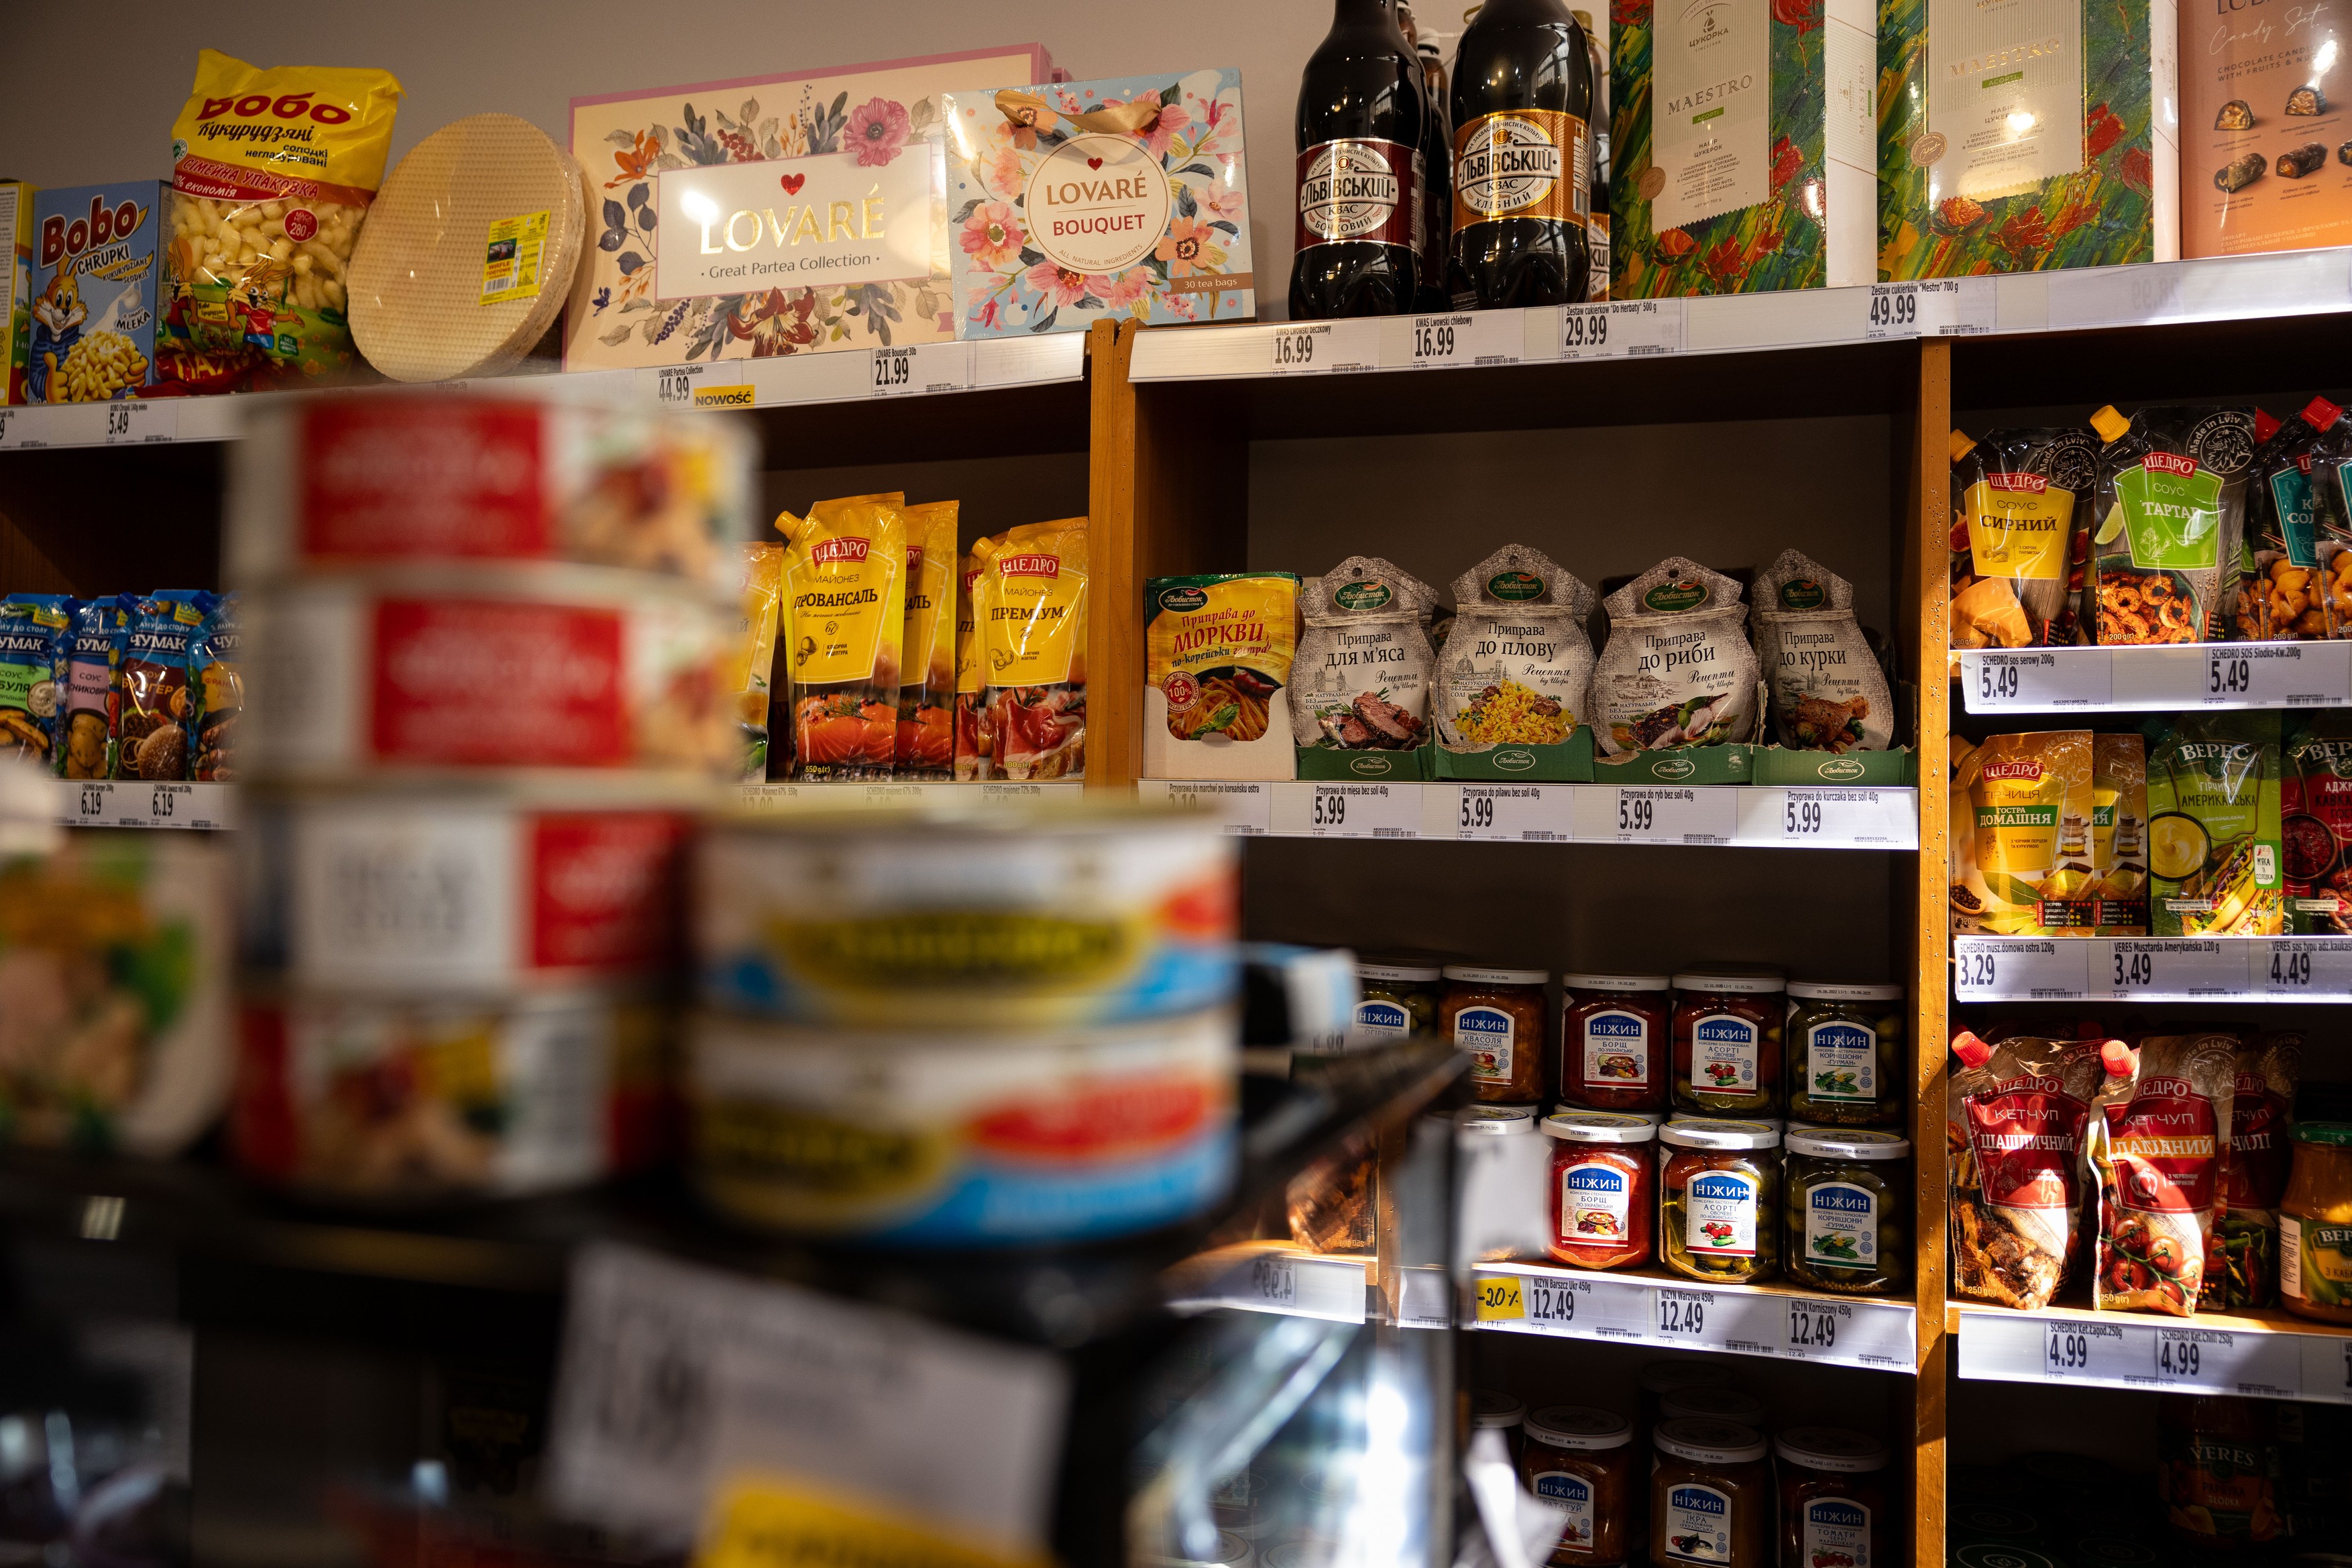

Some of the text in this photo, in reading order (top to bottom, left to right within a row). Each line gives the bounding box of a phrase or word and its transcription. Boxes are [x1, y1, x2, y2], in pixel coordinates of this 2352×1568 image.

[2209, 3, 2329, 55] Candy Set
[1689, 27, 1729, 48] ЦУКОРКА
[1949, 39, 2059, 79] MAESTRO
[2218, 54, 2274, 74] CHOCOLATE
[1668, 75, 1752, 115] MAESTRO
[1697, 111, 1719, 121] АСОРТІ
[198, 121, 315, 142] Кукурудзяні
[283, 144, 327, 158] солодкі
[1694, 145, 1722, 157] ЦУКЕРОК
[1461, 149, 1551, 184] ЛЬВІВСЬКИЙ
[182, 158, 318, 199] СІМЕЙНА УПАКОВКА
[1487, 179, 1518, 191] КВАС
[1047, 169, 1147, 206] LOVARÉ
[1304, 176, 1390, 207] ЛЬВІВСЬКИЙ
[1329, 205, 1358, 215] КВАС
[699, 182, 886, 255] LOVARÉ
[1052, 214, 1145, 236] BOUQUET
[40, 194, 139, 269] Bobo
[77, 244, 129, 275] CHRUPKI
[710, 254, 871, 278] Great Partea Collection
[1184, 277, 1238, 288] 30 tea bags
[1871, 281, 1958, 296] Zestaw cukierków "Mestro" 700 g
[1567, 302, 1657, 317] Zestaw cukierków "Do Herbaty" 500 g
[1870, 294, 1916, 326] 49.99
[117, 312, 151, 330] MLEKA
[1416, 315, 1473, 327] KWAS Lwowski chlebowy
[1565, 315, 1607, 346] 29.99
[1276, 335, 1313, 363] 16.99
[1415, 326, 1454, 357] 16.99
[876, 349, 891, 358] LOVARE
[892, 348, 908, 358] Bouquet
[659, 366, 704, 378] LOVARE Partea Collection
[876, 357, 909, 385] 21.99
[659, 376, 689, 402] 44.99
[695, 391, 751, 406] NOWOŚĆ
[109, 412, 129, 434] 5.49
[2145, 455, 2193, 473] ЩЕДРО
[1991, 475, 2044, 490] ЩЕДРО
[2153, 483, 2185, 496] СОУС
[1997, 500, 2037, 510] СОУС
[1981, 516, 2057, 531] СИРНИЙ
[1003, 559, 1056, 573] ЩЕДРО
[814, 574, 859, 584] МАЙОНЕЗ
[1494, 581, 1537, 590] Любисток
[794, 589, 878, 608] ПРОВАНСАЛЬ
[1005, 587, 1053, 596] МАЙОНЕЗ
[1165, 595, 1202, 603] Любисток
[1341, 588, 1385, 601] Любисток
[1652, 590, 1700, 602] Любисток
[991, 606, 1064, 621] ПРЕМІУМ
[1182, 608, 1255, 628] Приправа до
[1488, 622, 1545, 638] Приправа
[130, 636, 186, 650] ЧУМАК
[1174, 622, 1264, 655] МОРКВИ
[1337, 632, 1392, 649] Приправа
[1645, 630, 1706, 650] Приправа
[1785, 632, 1835, 648] Приправа
[1172, 646, 1230, 668] по-корейськи
[1326, 652, 1358, 669] для
[1638, 642, 1716, 673] до риби
[1780, 650, 1847, 671] до курки
[1982, 655, 2054, 667] SCHEDRO sos serowy 200g
[1375, 670, 1418, 684] Рецепти
[1522, 664, 1571, 677] Рецепти
[1687, 669, 1736, 684] Рецепти
[2210, 660, 2249, 692] 5.49
[1821, 672, 1860, 687] Рецепти
[1981, 667, 2018, 698] 5.49
[1168, 687, 1192, 697] 100%
[2179, 743, 2249, 761] ВЕРЕС
[1499, 757, 1530, 765] Любисток
[1985, 765, 2040, 777] ЩЕДРО
[1316, 786, 1388, 797] Przyprawa do mięsa bez soli 40g
[1463, 787, 1540, 799] Przyprawa do pilawu bez soli 40g
[1984, 790, 2040, 799] ГІРЧИЦЯ
[81, 792, 101, 815] 6.19
[153, 793, 173, 816] 6.19
[1314, 795, 1345, 824] 5.99
[1461, 797, 1493, 827] 5.99
[1619, 799, 1653, 830] 5.99
[1786, 801, 1821, 833] 5.99
[1980, 814, 2052, 827] ДОМАШНЯ
[1960, 942, 2055, 954] SCHEDRO musz.domowa ostra 120g
[2114, 941, 2220, 954] VERES Musztarda Amerykańska 120 g
[2272, 940, 2290, 951] VERES
[2292, 943, 2302, 951] sos
[2303, 942, 2316, 954] typu
[1960, 954, 1995, 986] 3.29
[2114, 954, 2151, 985] 3.49
[2271, 953, 2310, 985] 4.49
[1358, 1011, 1402, 1025] НІЖИН
[1462, 1019, 1505, 1031] НІЖИН
[1593, 1024, 1639, 1035] НІЖИН
[1701, 1028, 1748, 1040] НІЖИН
[1464, 1035, 1502, 1044] КВАСОЛЯ
[1817, 1035, 1866, 1046] НІЖИН
[1995, 1109, 2059, 1121] КЕТЧУП
[2125, 1113, 2194, 1125] КЕТЧУП
[1980, 1133, 2074, 1152] ШАШЛИЧНИЙ
[2115, 1137, 2213, 1156] ЛАГІДНИЙ
[1570, 1176, 1621, 1190] НІЖИН
[1695, 1184, 1748, 1198] НІЖИН
[1581, 1194, 1607, 1205] БОРЩ
[1815, 1194, 1868, 1210] НІЖИН
[1703, 1204, 1737, 1213] АСОРТІ
[1817, 1215, 1864, 1225] КОРНІШОНИ
[1534, 1277, 1591, 1293] NIŻYN Barszcz Ukr 450g
[1661, 1288, 1714, 1304] NIŻYN Warzywa 450g
[1533, 1289, 1574, 1321] 12.49
[1791, 1300, 1851, 1318] NIŻYN Korniszony 450g
[1661, 1300, 1703, 1333] 12.49
[1791, 1312, 1835, 1347] 12.49
[2050, 1335, 2087, 1367] 4.99
[2161, 1342, 2200, 1376] 4.99
[2188, 1445, 2255, 1467] VERES
[1541, 1483, 1585, 1499] НІЖИН
[1675, 1495, 1722, 1511] НІЖИН
[1686, 1515, 1707, 1525] ІКРА
[1812, 1510, 1862, 1525] НІЖИН
[1817, 1528, 1856, 1539] ТОМАТИ
